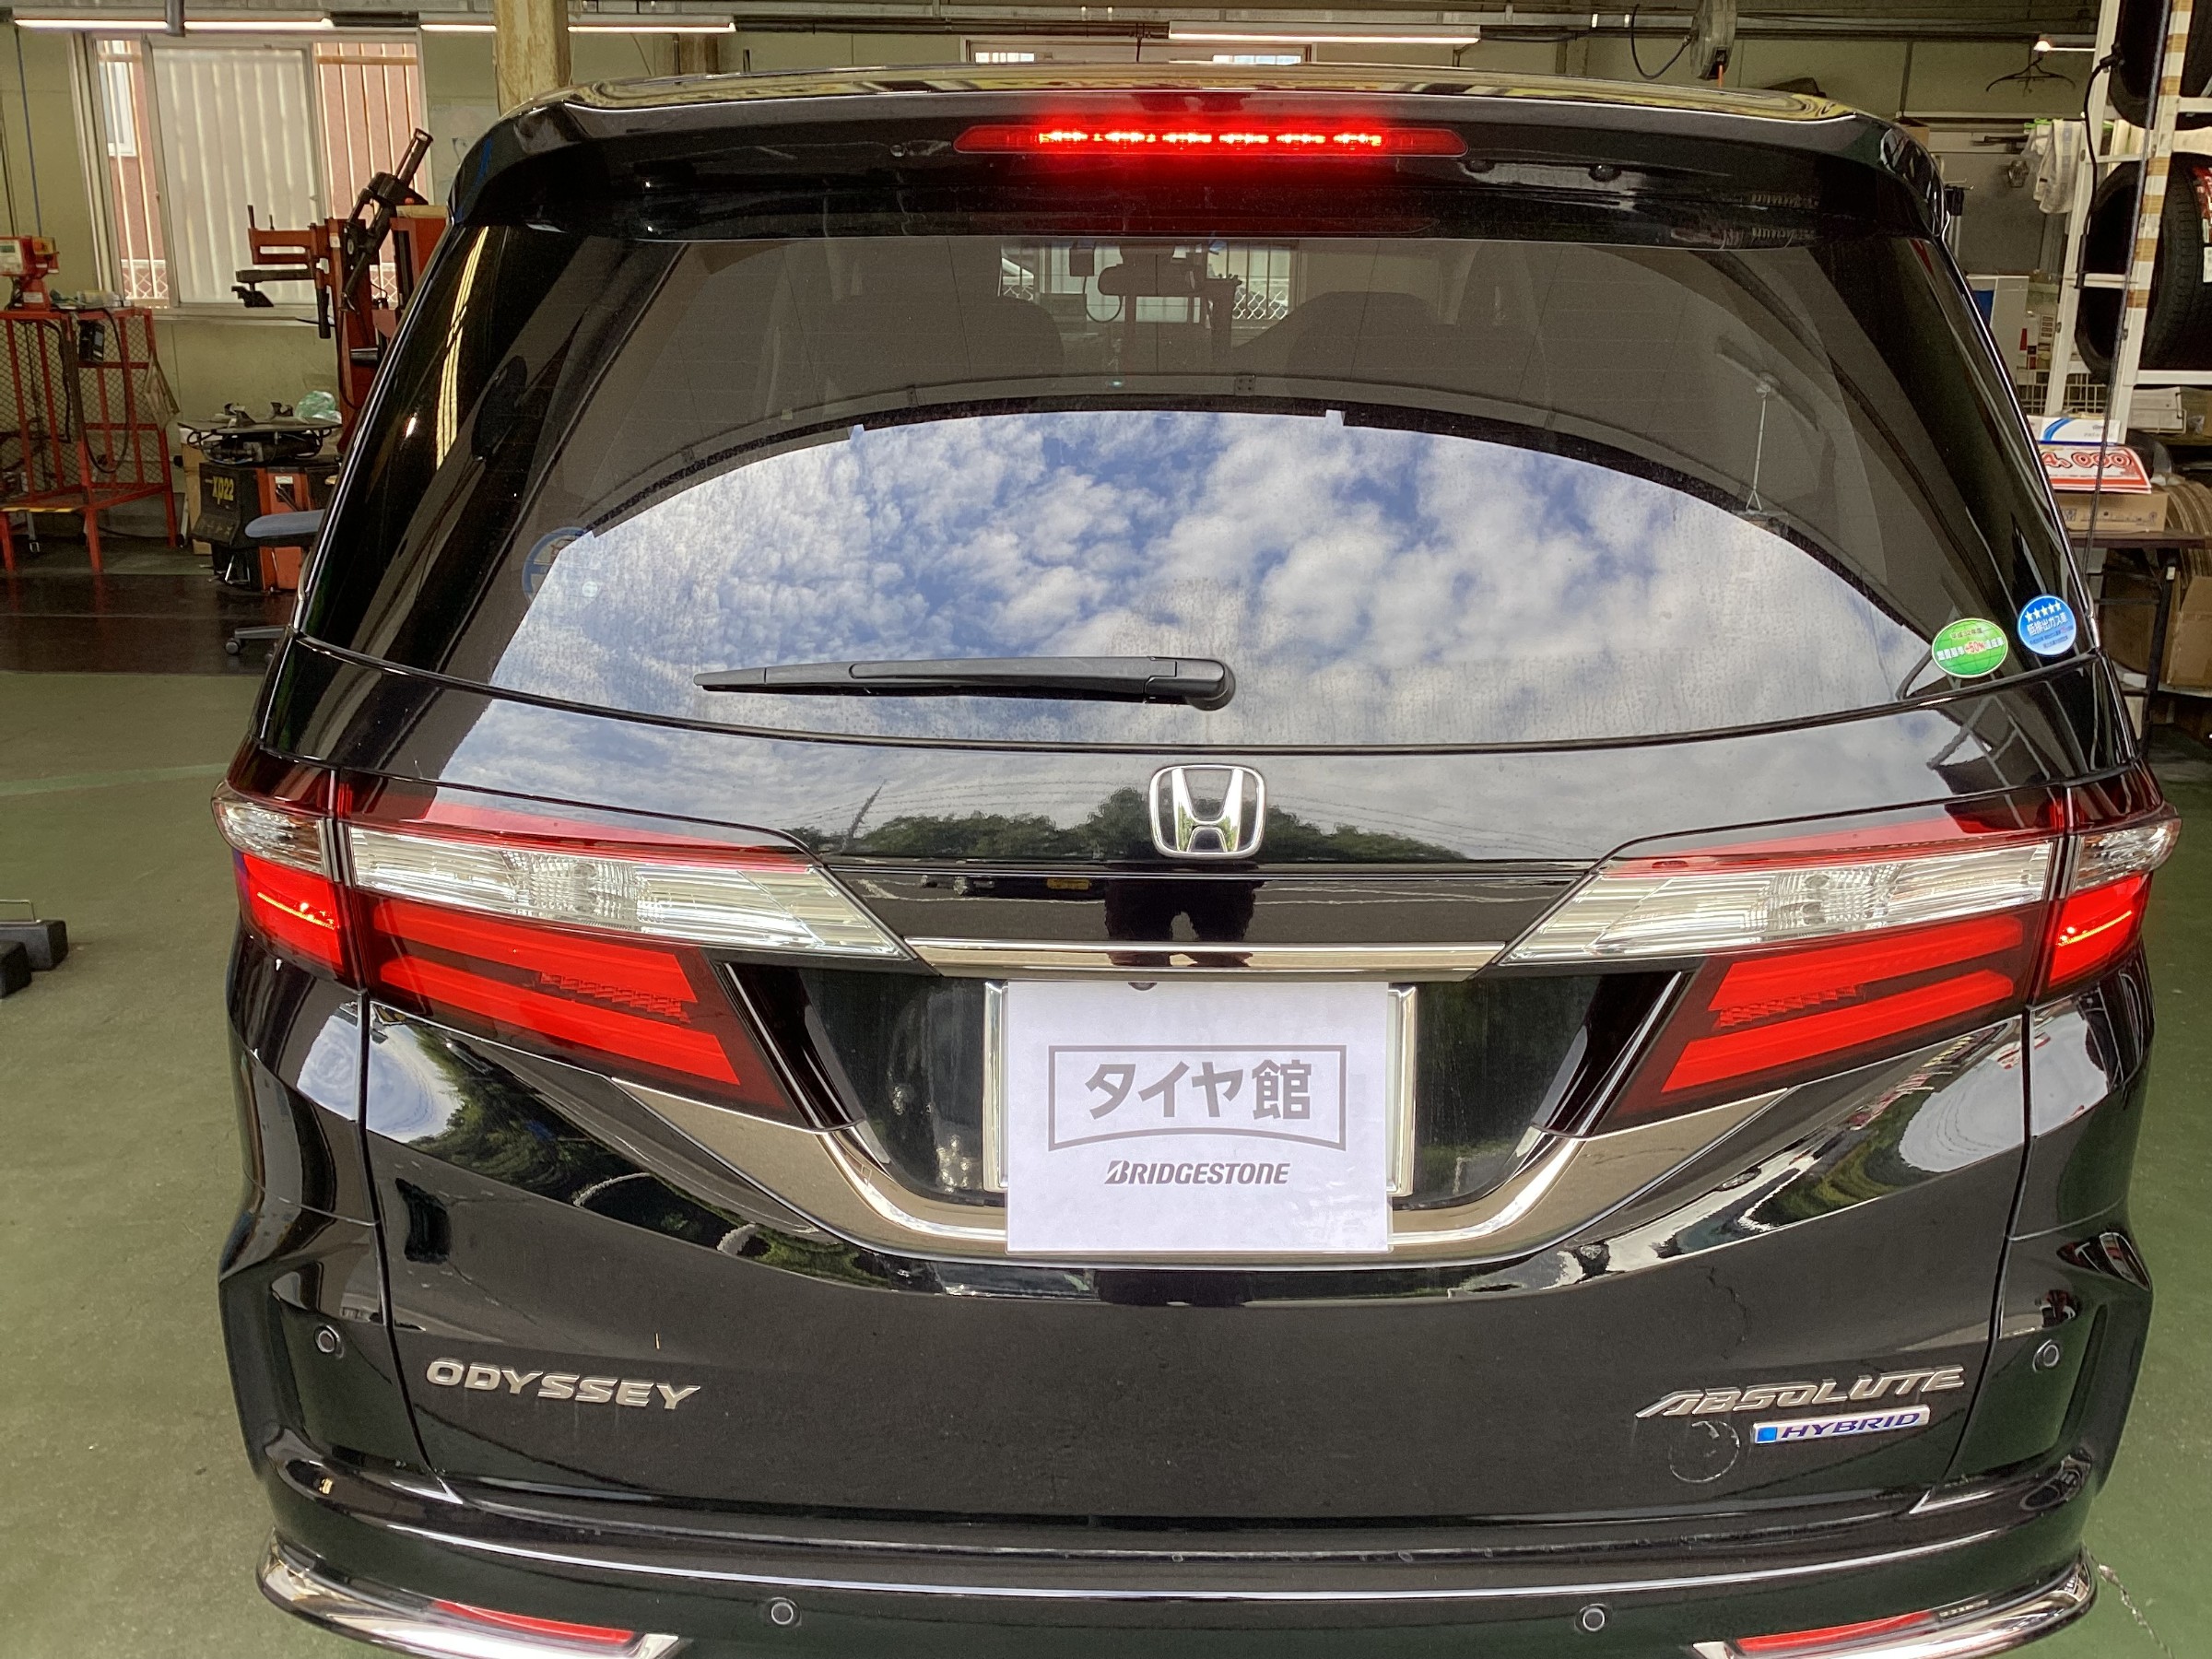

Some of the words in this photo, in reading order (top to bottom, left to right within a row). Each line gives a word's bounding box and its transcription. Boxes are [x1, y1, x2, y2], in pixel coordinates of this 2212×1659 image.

[1085, 1059, 1312, 1121] タイヤ館
[1104, 1159, 1290, 1185] BRIDGESTONE
[426, 1357, 701, 1410] ODYSSEY
[1635, 1364, 1965, 1418] ABSOLUTE
[1781, 1411, 1921, 1440] HYBRID
